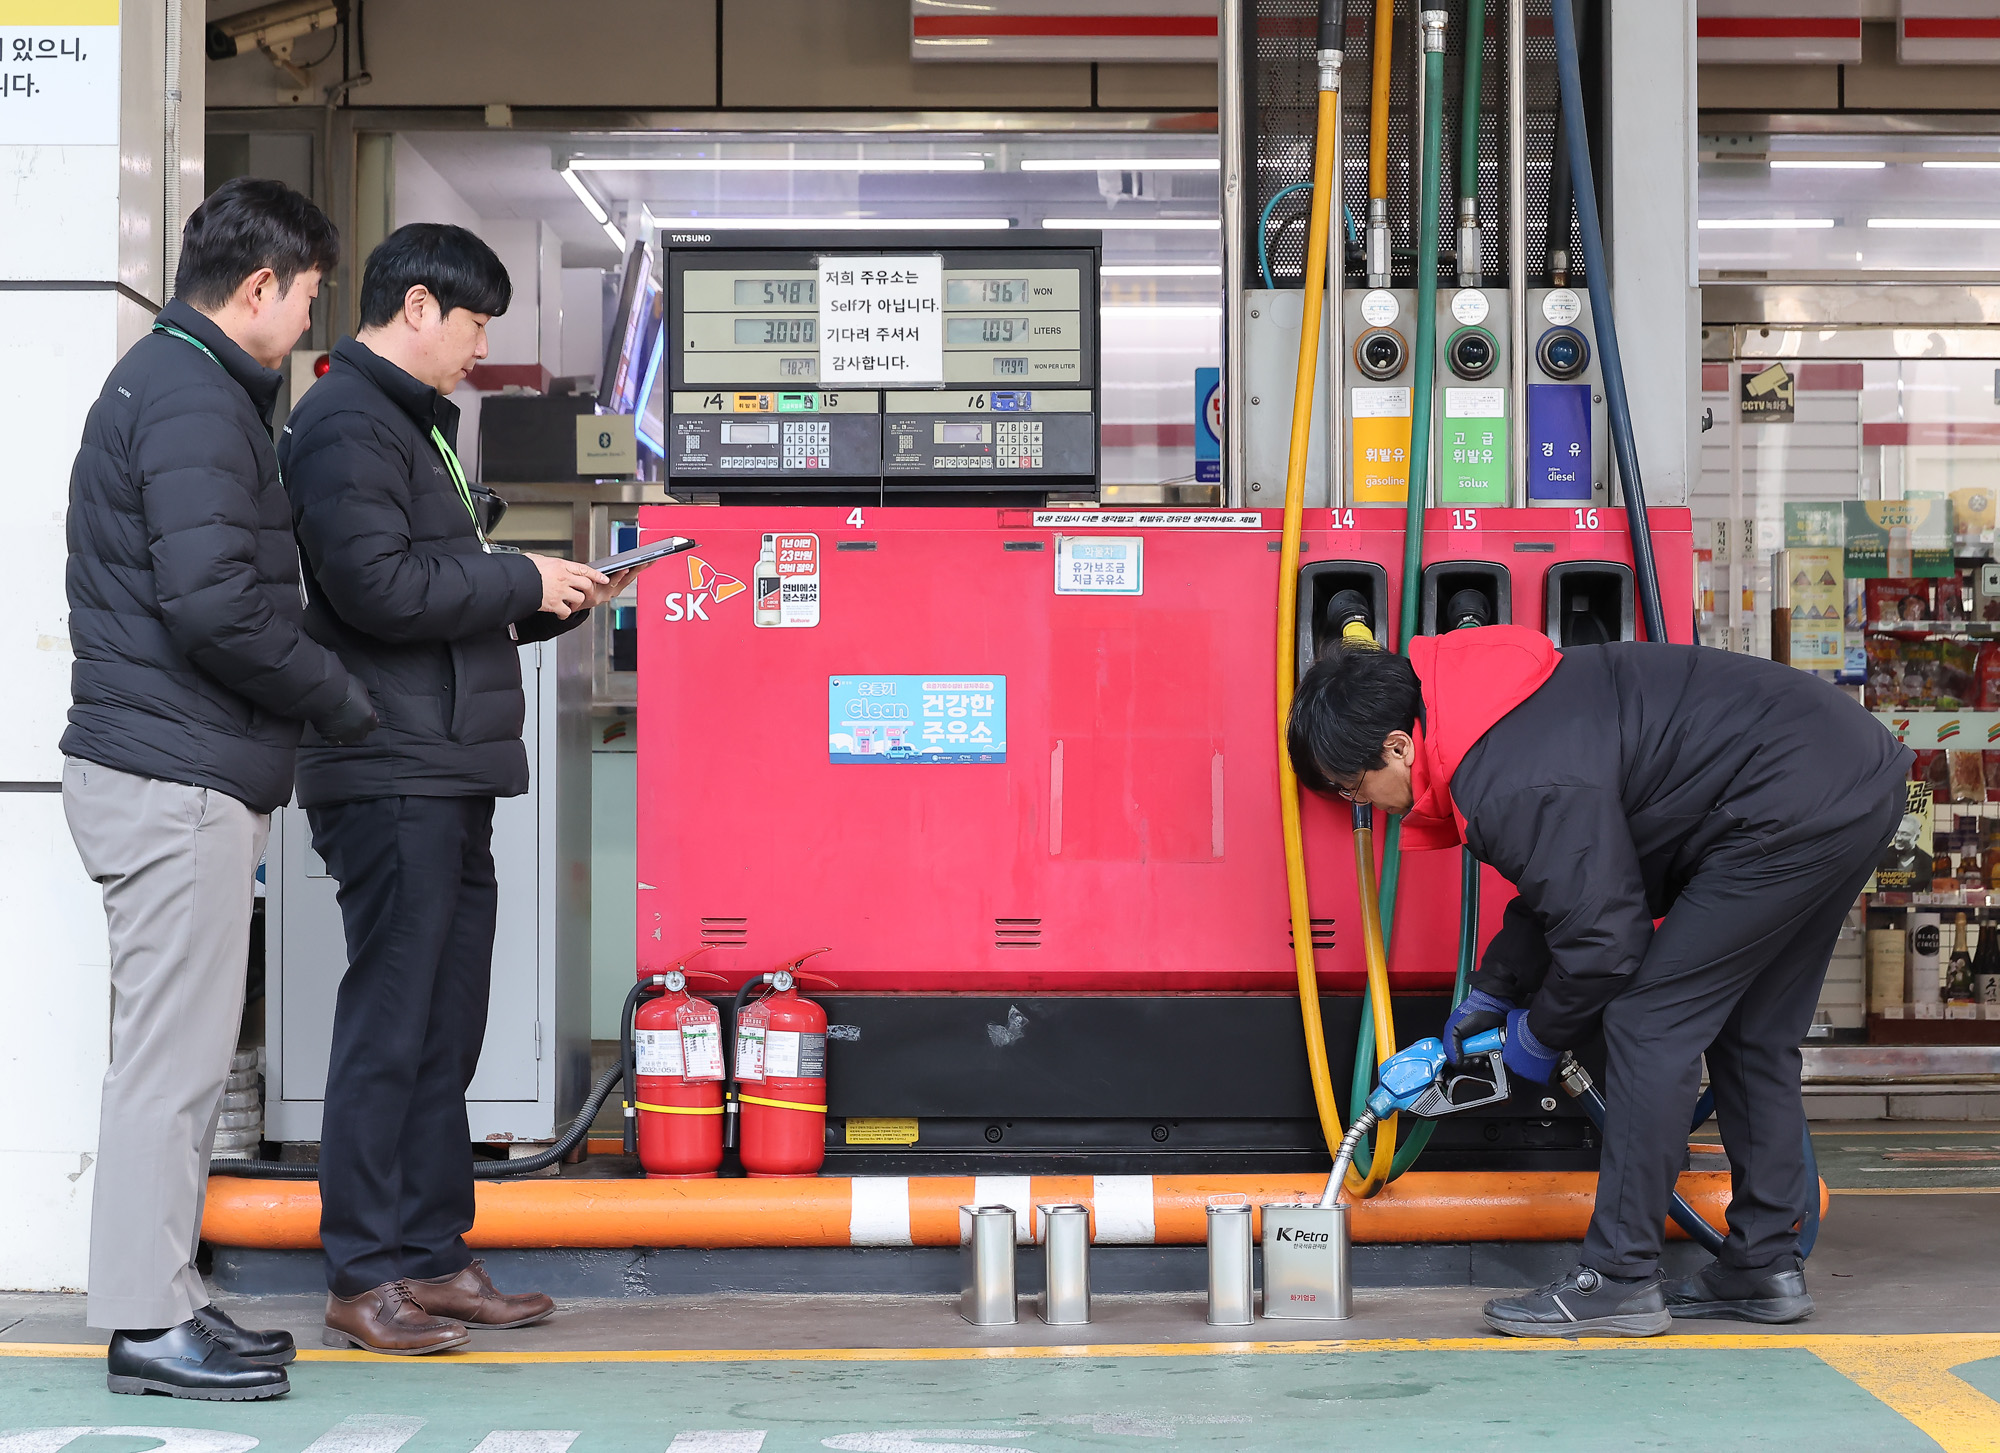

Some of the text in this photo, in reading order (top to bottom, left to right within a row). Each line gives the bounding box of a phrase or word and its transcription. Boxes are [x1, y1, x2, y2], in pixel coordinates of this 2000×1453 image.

[12, 37, 87, 62] 있으니,
[671, 234, 711, 242] TATSUNO
[825, 270, 919, 285] 저희 주유소는
[763, 282, 814, 304] 5481
[982, 281, 1053, 302] 1961 WON
[831, 298, 940, 313] Self가 아닙니다.
[763, 321, 814, 344] 3.000
[826, 327, 920, 343] 기다려 주셔서
[1033, 327, 1062, 335] LITERS
[786, 361, 811, 375] 1827
[832, 355, 909, 371] 감사합니다.
[1000, 360, 1023, 374] 1797
[703, 393, 724, 411] 14
[823, 394, 839, 407] 15
[968, 394, 985, 409] 16
[1742, 402, 1766, 410] CCTV
[722, 459, 778, 467] P1 P2 P3 P4 P5
[1365, 448, 1405, 463] 휘발유
[1452, 449, 1494, 464] 휘발유
[1365, 476, 1405, 487] gasoline
[1458, 477, 1489, 488] solux
[1547, 470, 1575, 482] diesel
[846, 507, 865, 529] 4
[1035, 515, 1053, 524] 차량
[1054, 515, 1080, 524] 진입시
[1081, 515, 1099, 524] 다른
[1100, 515, 1134, 524] 생각말고
[1193, 515, 1236, 524] 생각하세요.
[1239, 516, 1258, 524] 제발
[1331, 509, 1355, 529] 14
[1452, 510, 1477, 530] 15
[1574, 509, 1599, 529] 16
[780, 550, 813, 562] 23만원
[1072, 562, 1126, 574] 유가보조금
[1072, 574, 1126, 586] 지급 주유소
[782, 583, 817, 593] 연비에샷
[782, 593, 817, 603] 불스원샷
[664, 592, 710, 622] SK
[858, 681, 897, 696] 유증기
[845, 698, 909, 719] Clean
[922, 693, 995, 718] 건강한
[922, 720, 994, 744] 주유소
[1276, 1227, 1328, 1242] K Petro
[1290, 1294, 1316, 1302] 화기엄금
